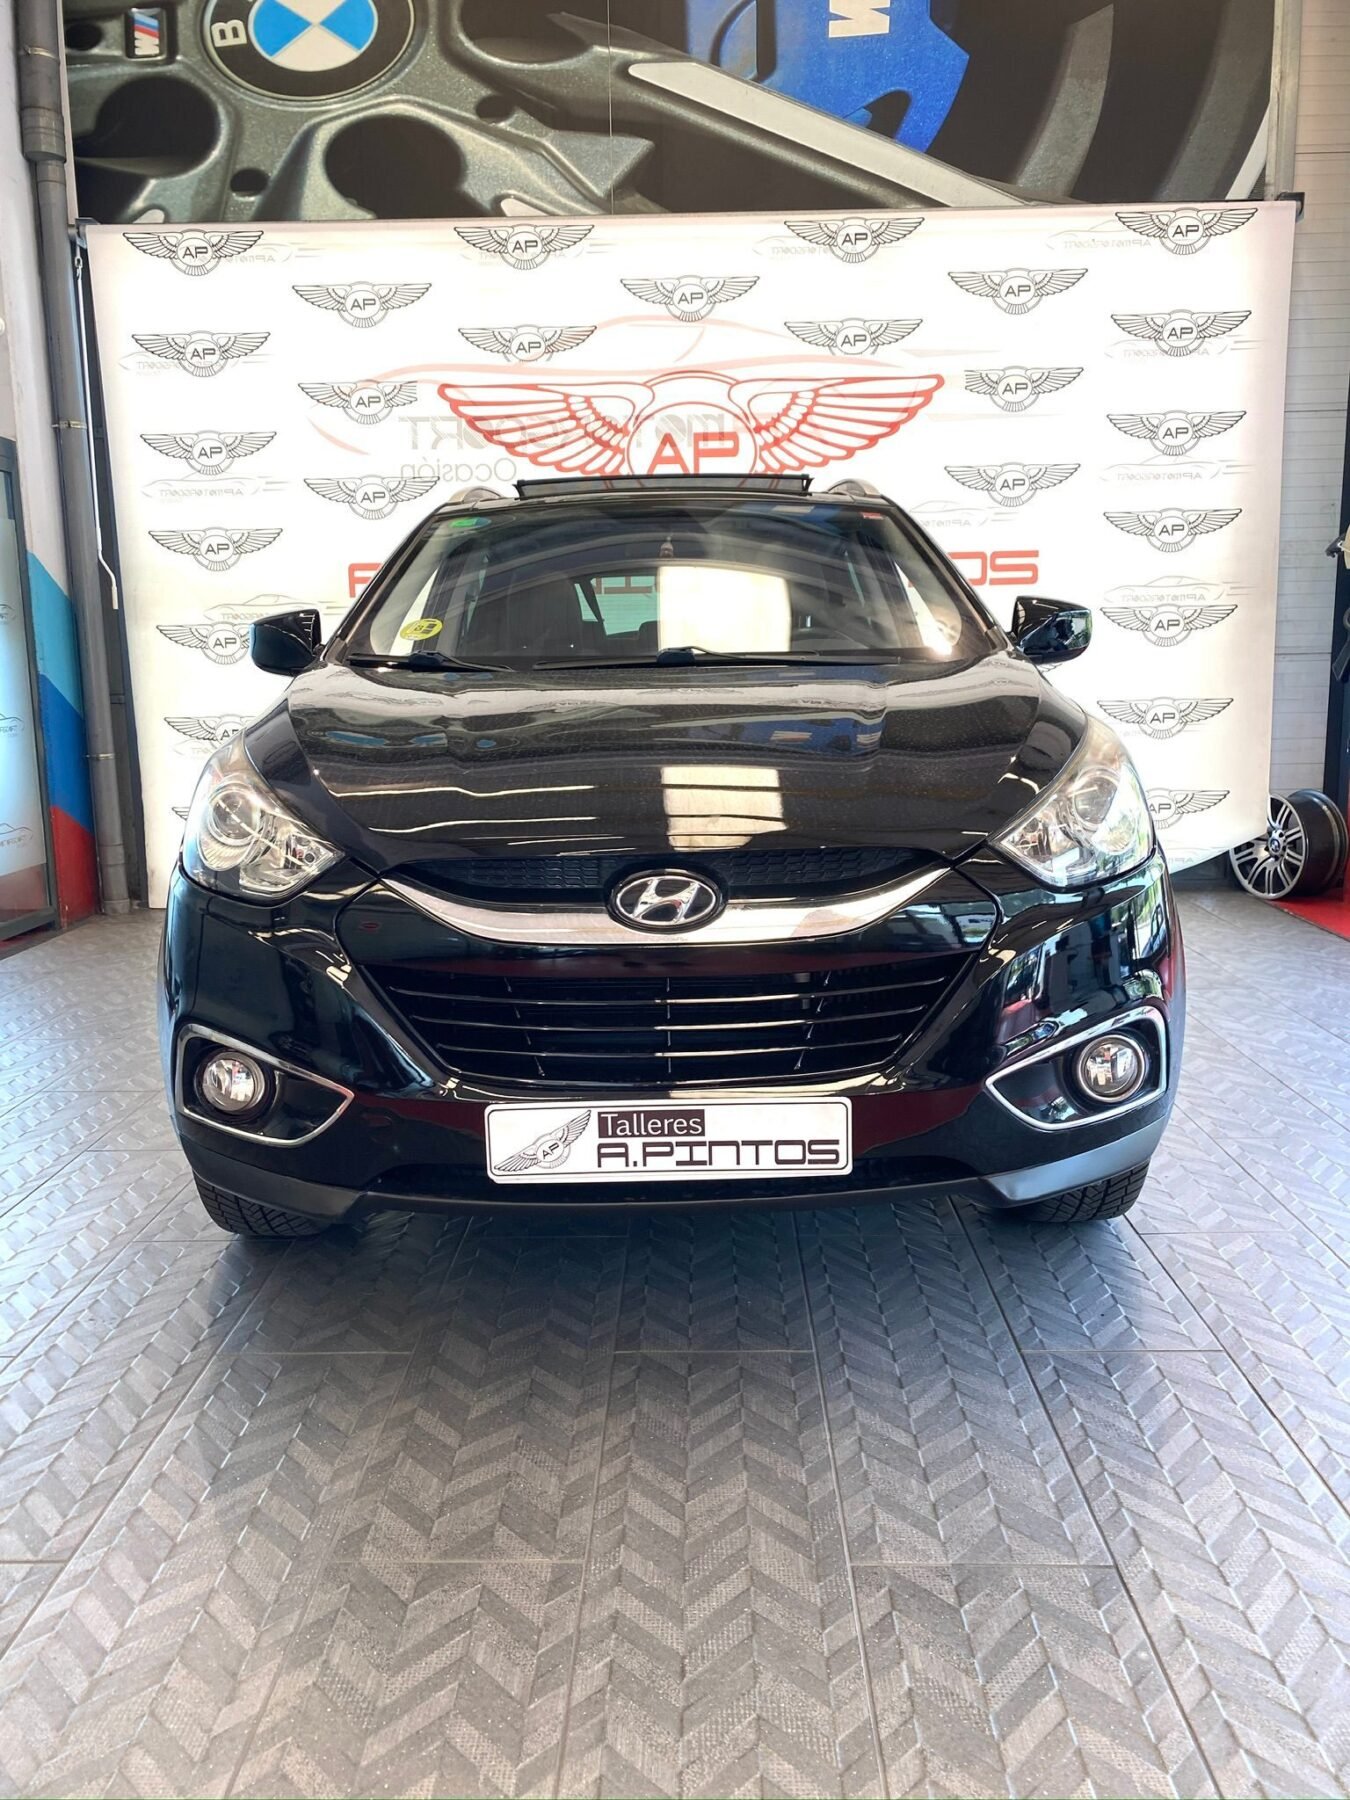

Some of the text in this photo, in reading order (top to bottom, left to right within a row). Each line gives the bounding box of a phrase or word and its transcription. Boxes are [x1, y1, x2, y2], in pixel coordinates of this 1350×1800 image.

[1172, 224, 1199, 238] AP
[841, 232, 868, 246] AP
[182, 246, 208, 259] AP
[512, 240, 538, 253] AP
[1004, 284, 1031, 297] AP
[350, 298, 376, 311] AP
[677, 292, 704, 304] AP
[1167, 327, 1193, 339] AP
[840, 334, 867, 347] AP
[190, 347, 216, 360] AP
[515, 341, 541, 354] AP
[1002, 382, 1028, 395] AP
[355, 396, 381, 408] AP
[1162, 427, 1189, 439] AP
[197, 446, 223, 459] AP
[647, 431, 739, 474] AP
[999, 478, 1025, 491] AP
[360, 491, 386, 503] AP
[1158, 524, 1185, 536] AP
[204, 543, 230, 555] AP
[1154, 619, 1180, 631] AP
[212, 637, 237, 649] AP
[1150, 712, 1175, 724] AP
[601, 1112, 703, 1137] Talleres
[542, 1143, 559, 1160] AP
[597, 1138, 841, 1168] A.PINTOS
